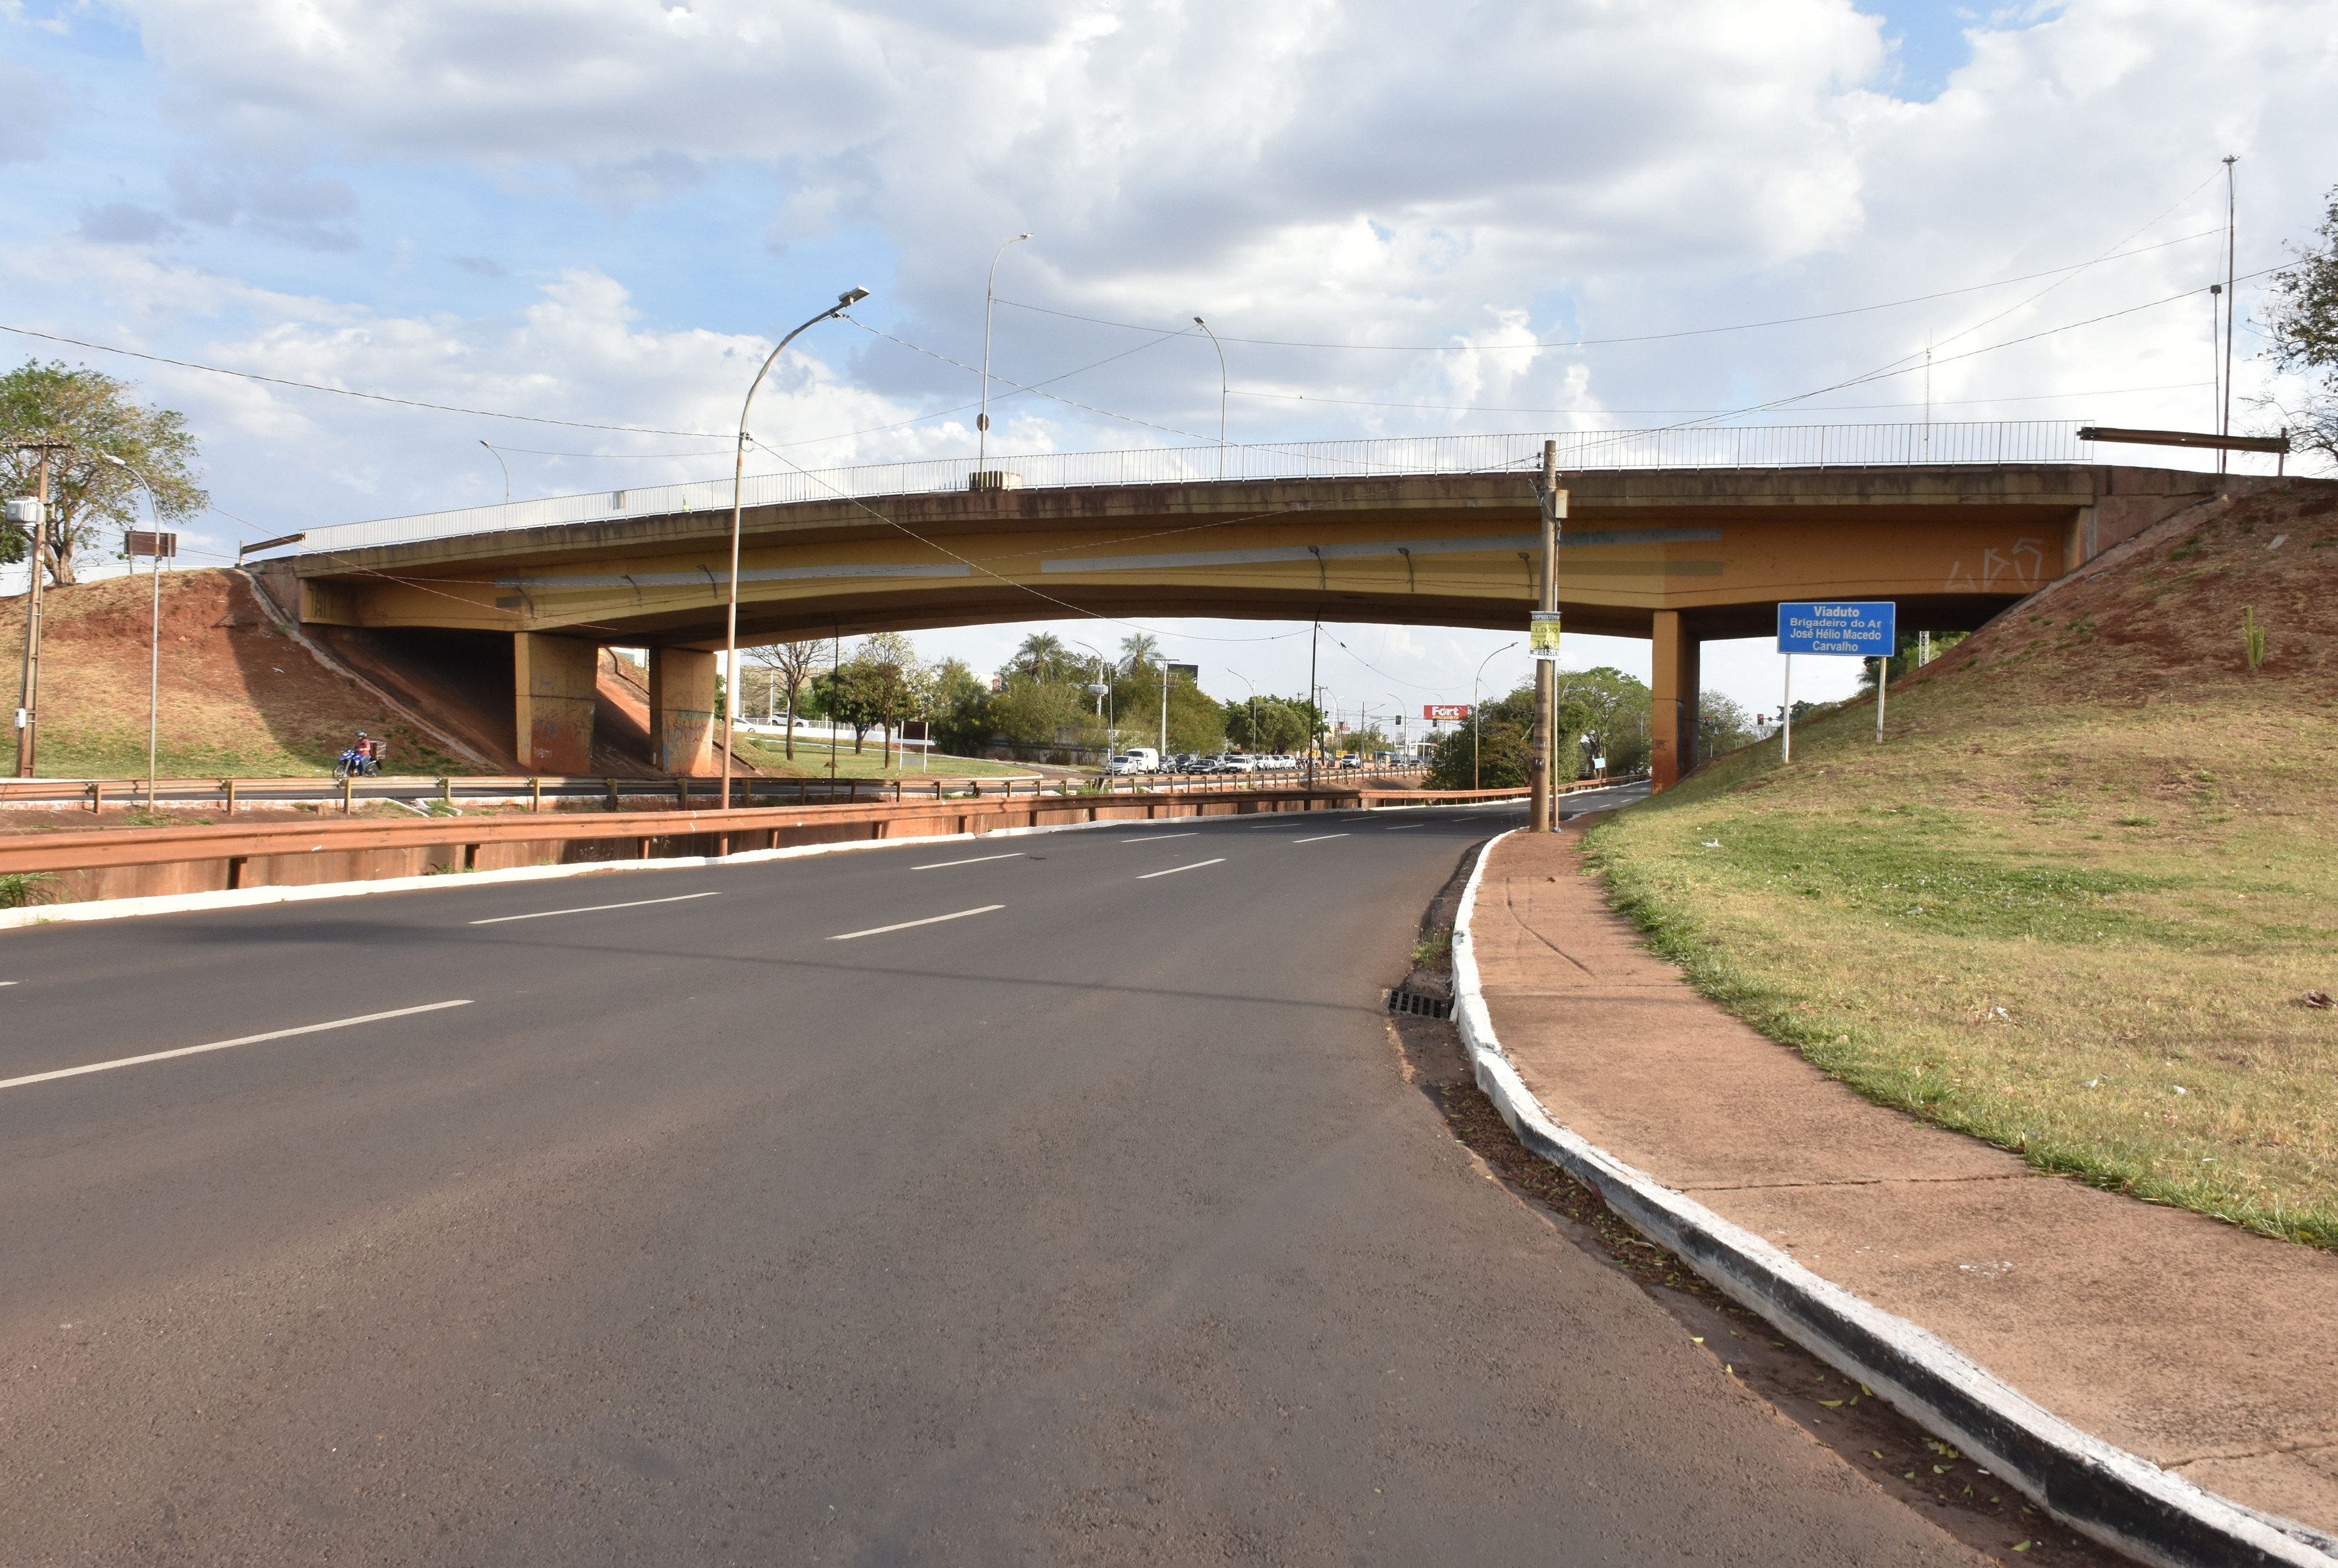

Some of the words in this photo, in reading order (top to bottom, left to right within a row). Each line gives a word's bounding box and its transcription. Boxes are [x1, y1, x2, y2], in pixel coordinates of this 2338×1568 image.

[1814, 606, 1859, 617] Viaduto
[1790, 618, 1847, 628] Brigadeiro
[1851, 619, 1865, 628] do
[1868, 620, 1881, 628] Ar
[1790, 628, 1813, 638] José
[1816, 628, 1841, 639] Hélio
[1843, 629, 1881, 640] Macedo
[1812, 640, 1859, 652] Carvalho
[1432, 706, 1459, 716] Fort
